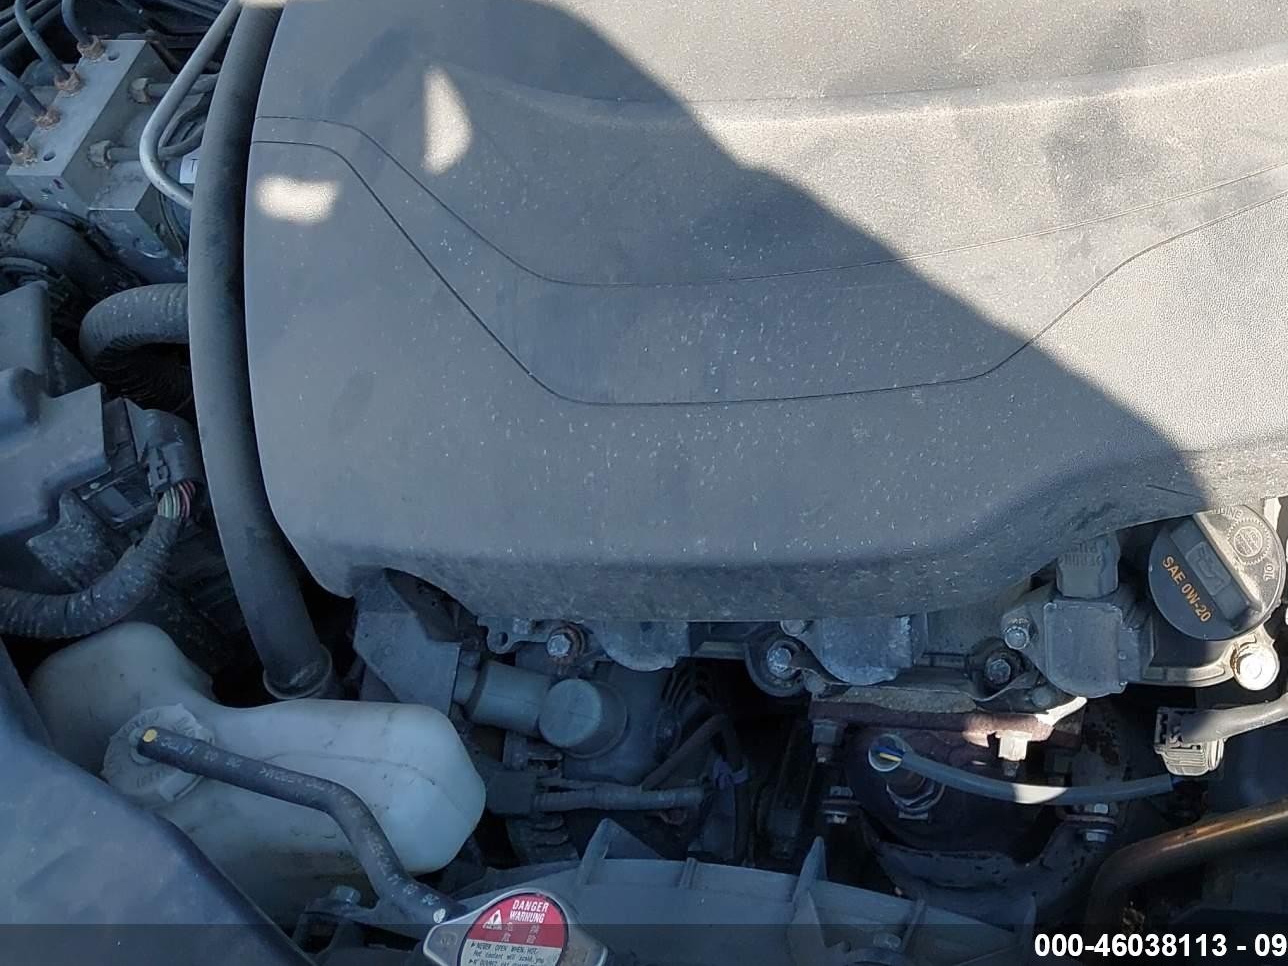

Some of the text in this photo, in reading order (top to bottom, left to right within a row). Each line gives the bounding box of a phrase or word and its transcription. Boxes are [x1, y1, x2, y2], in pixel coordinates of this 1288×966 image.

[1161, 555, 1214, 623] SAE 0W-20
[512, 899, 550, 913] DANGER
[509, 910, 546, 924] WARNUNG
